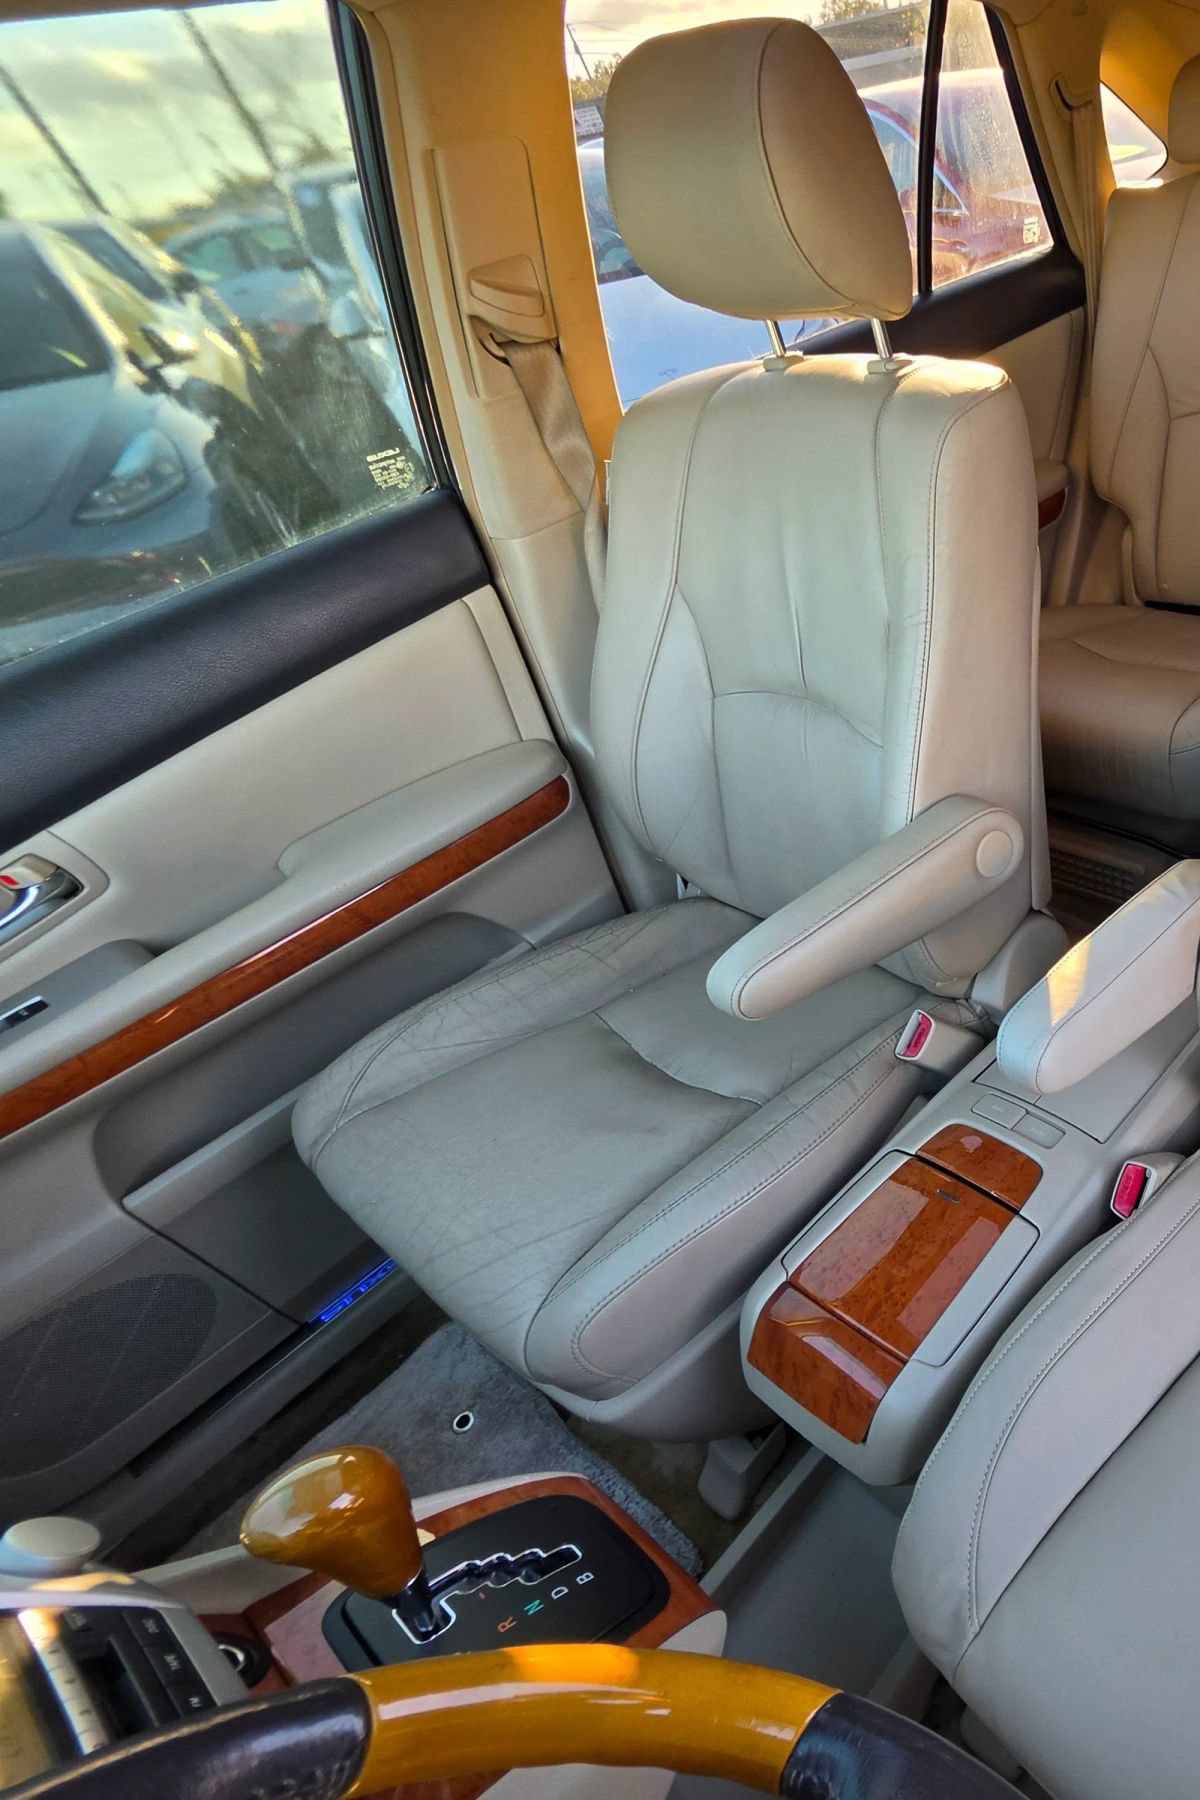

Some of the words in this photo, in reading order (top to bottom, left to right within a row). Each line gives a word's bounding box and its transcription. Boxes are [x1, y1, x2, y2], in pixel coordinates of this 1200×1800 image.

[576, 1572, 595, 1585] B
[551, 1586, 569, 1600] D
[523, 1599, 545, 1616] N
[497, 1616, 518, 1633] R
